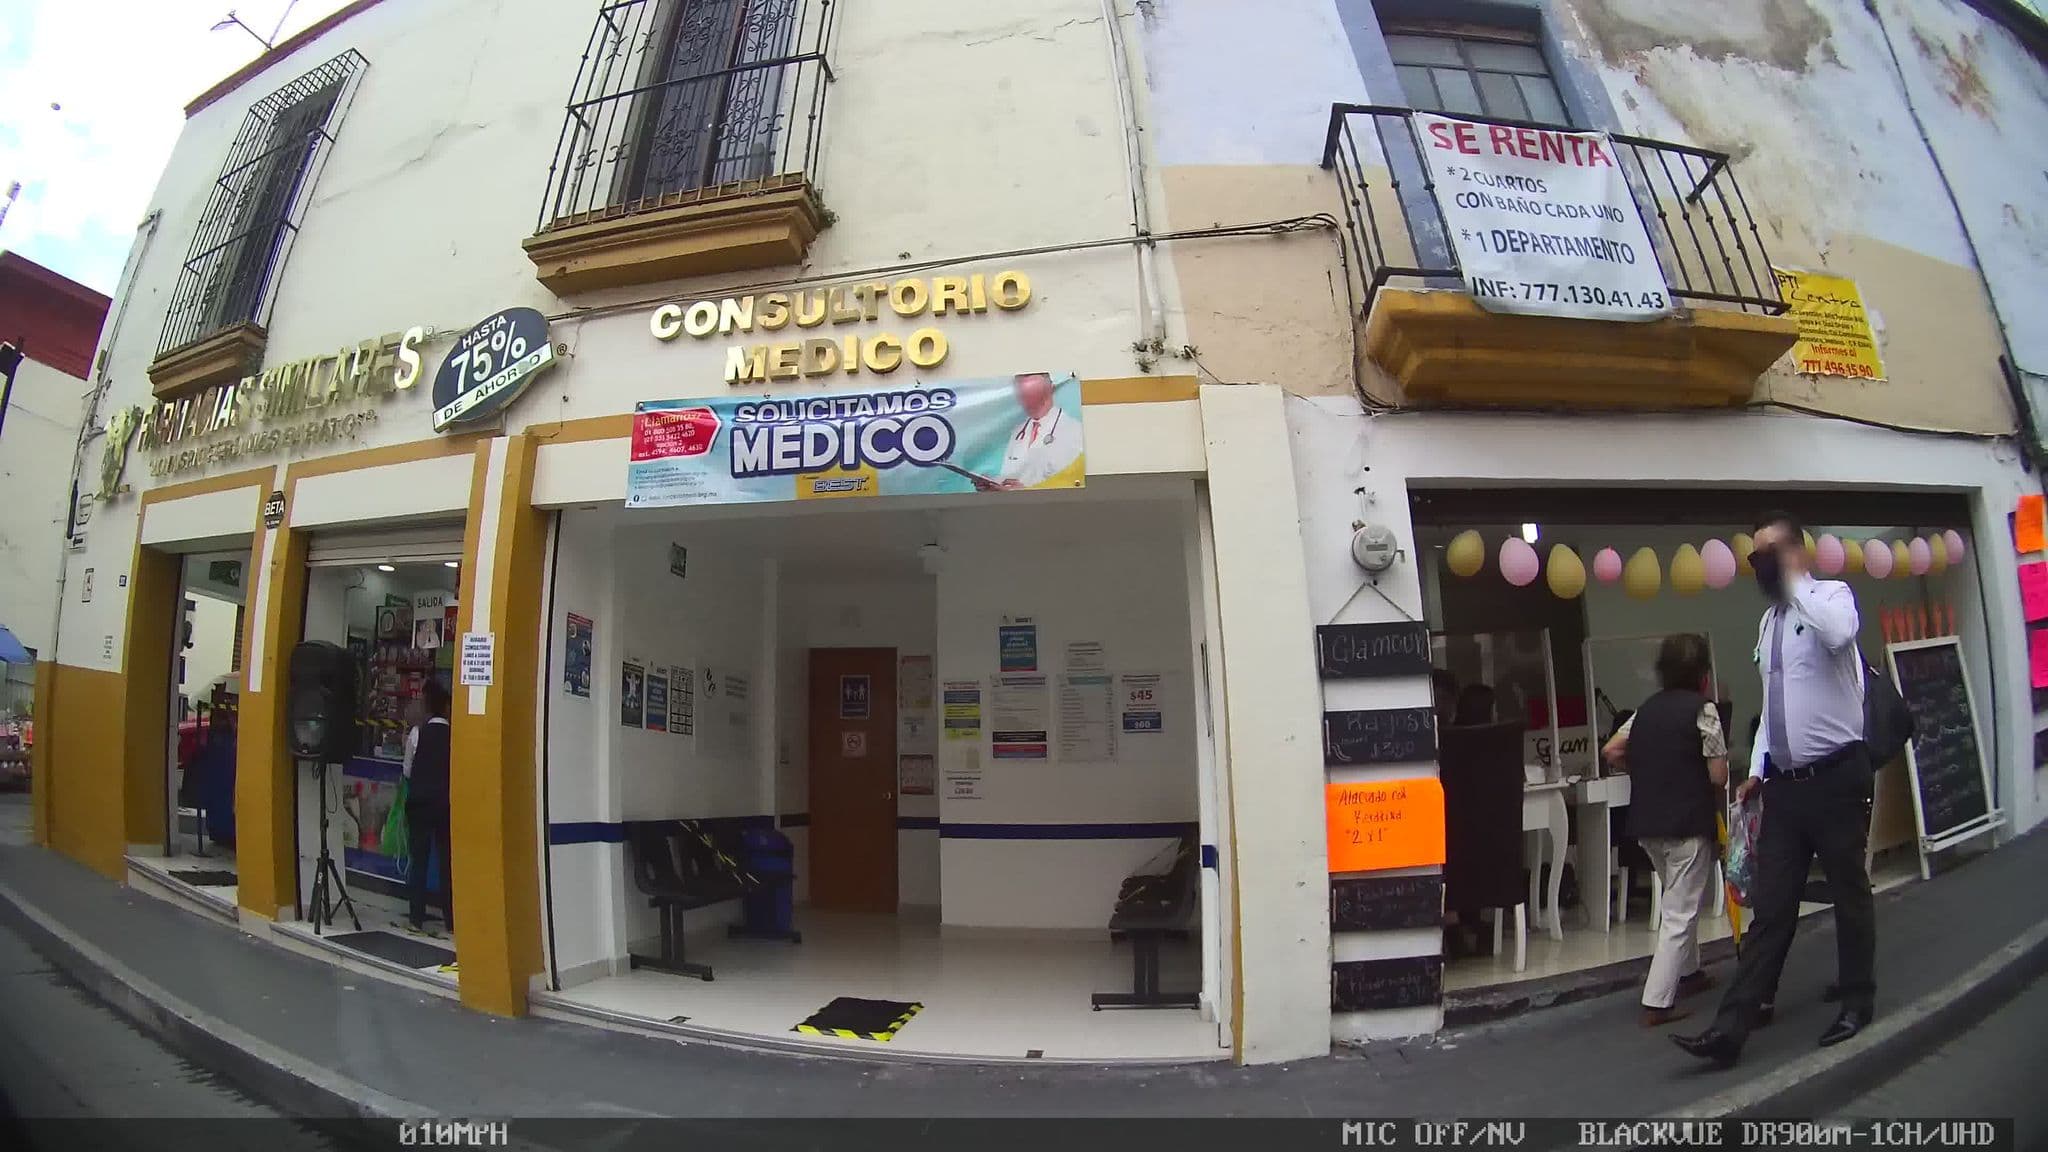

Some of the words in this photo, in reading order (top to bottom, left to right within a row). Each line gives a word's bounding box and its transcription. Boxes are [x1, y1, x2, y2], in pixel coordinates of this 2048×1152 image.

[1427, 123, 1480, 155] SE
[1489, 125, 1613, 167] RENTA
[1461, 167, 1471, 182] 2
[1474, 171, 1548, 193] CUARTOS
[1456, 191, 1493, 209] CON
[1497, 196, 1542, 216] BAÑO
[1545, 202, 1590, 219] CADA
[1592, 203, 1625, 223] UNO
[1476, 231, 1488, 252] 1
[1491, 229, 1635, 265] DEPARTAMENTO
[650, 270, 1032, 341] CONSULTORIO
[1471, 277, 1517, 299] INF:
[1520, 283, 1665, 309] 777.130.41.43
[462, 315, 507, 350] HASTA
[451, 320, 527, 395] 75%
[724, 326, 950, 385] MEDICO
[443, 401, 464, 420] DE
[475, 354, 541, 401] AHORO
[734, 389, 952, 423] SOLICITAMOS
[264, 500, 285, 516] BETA
